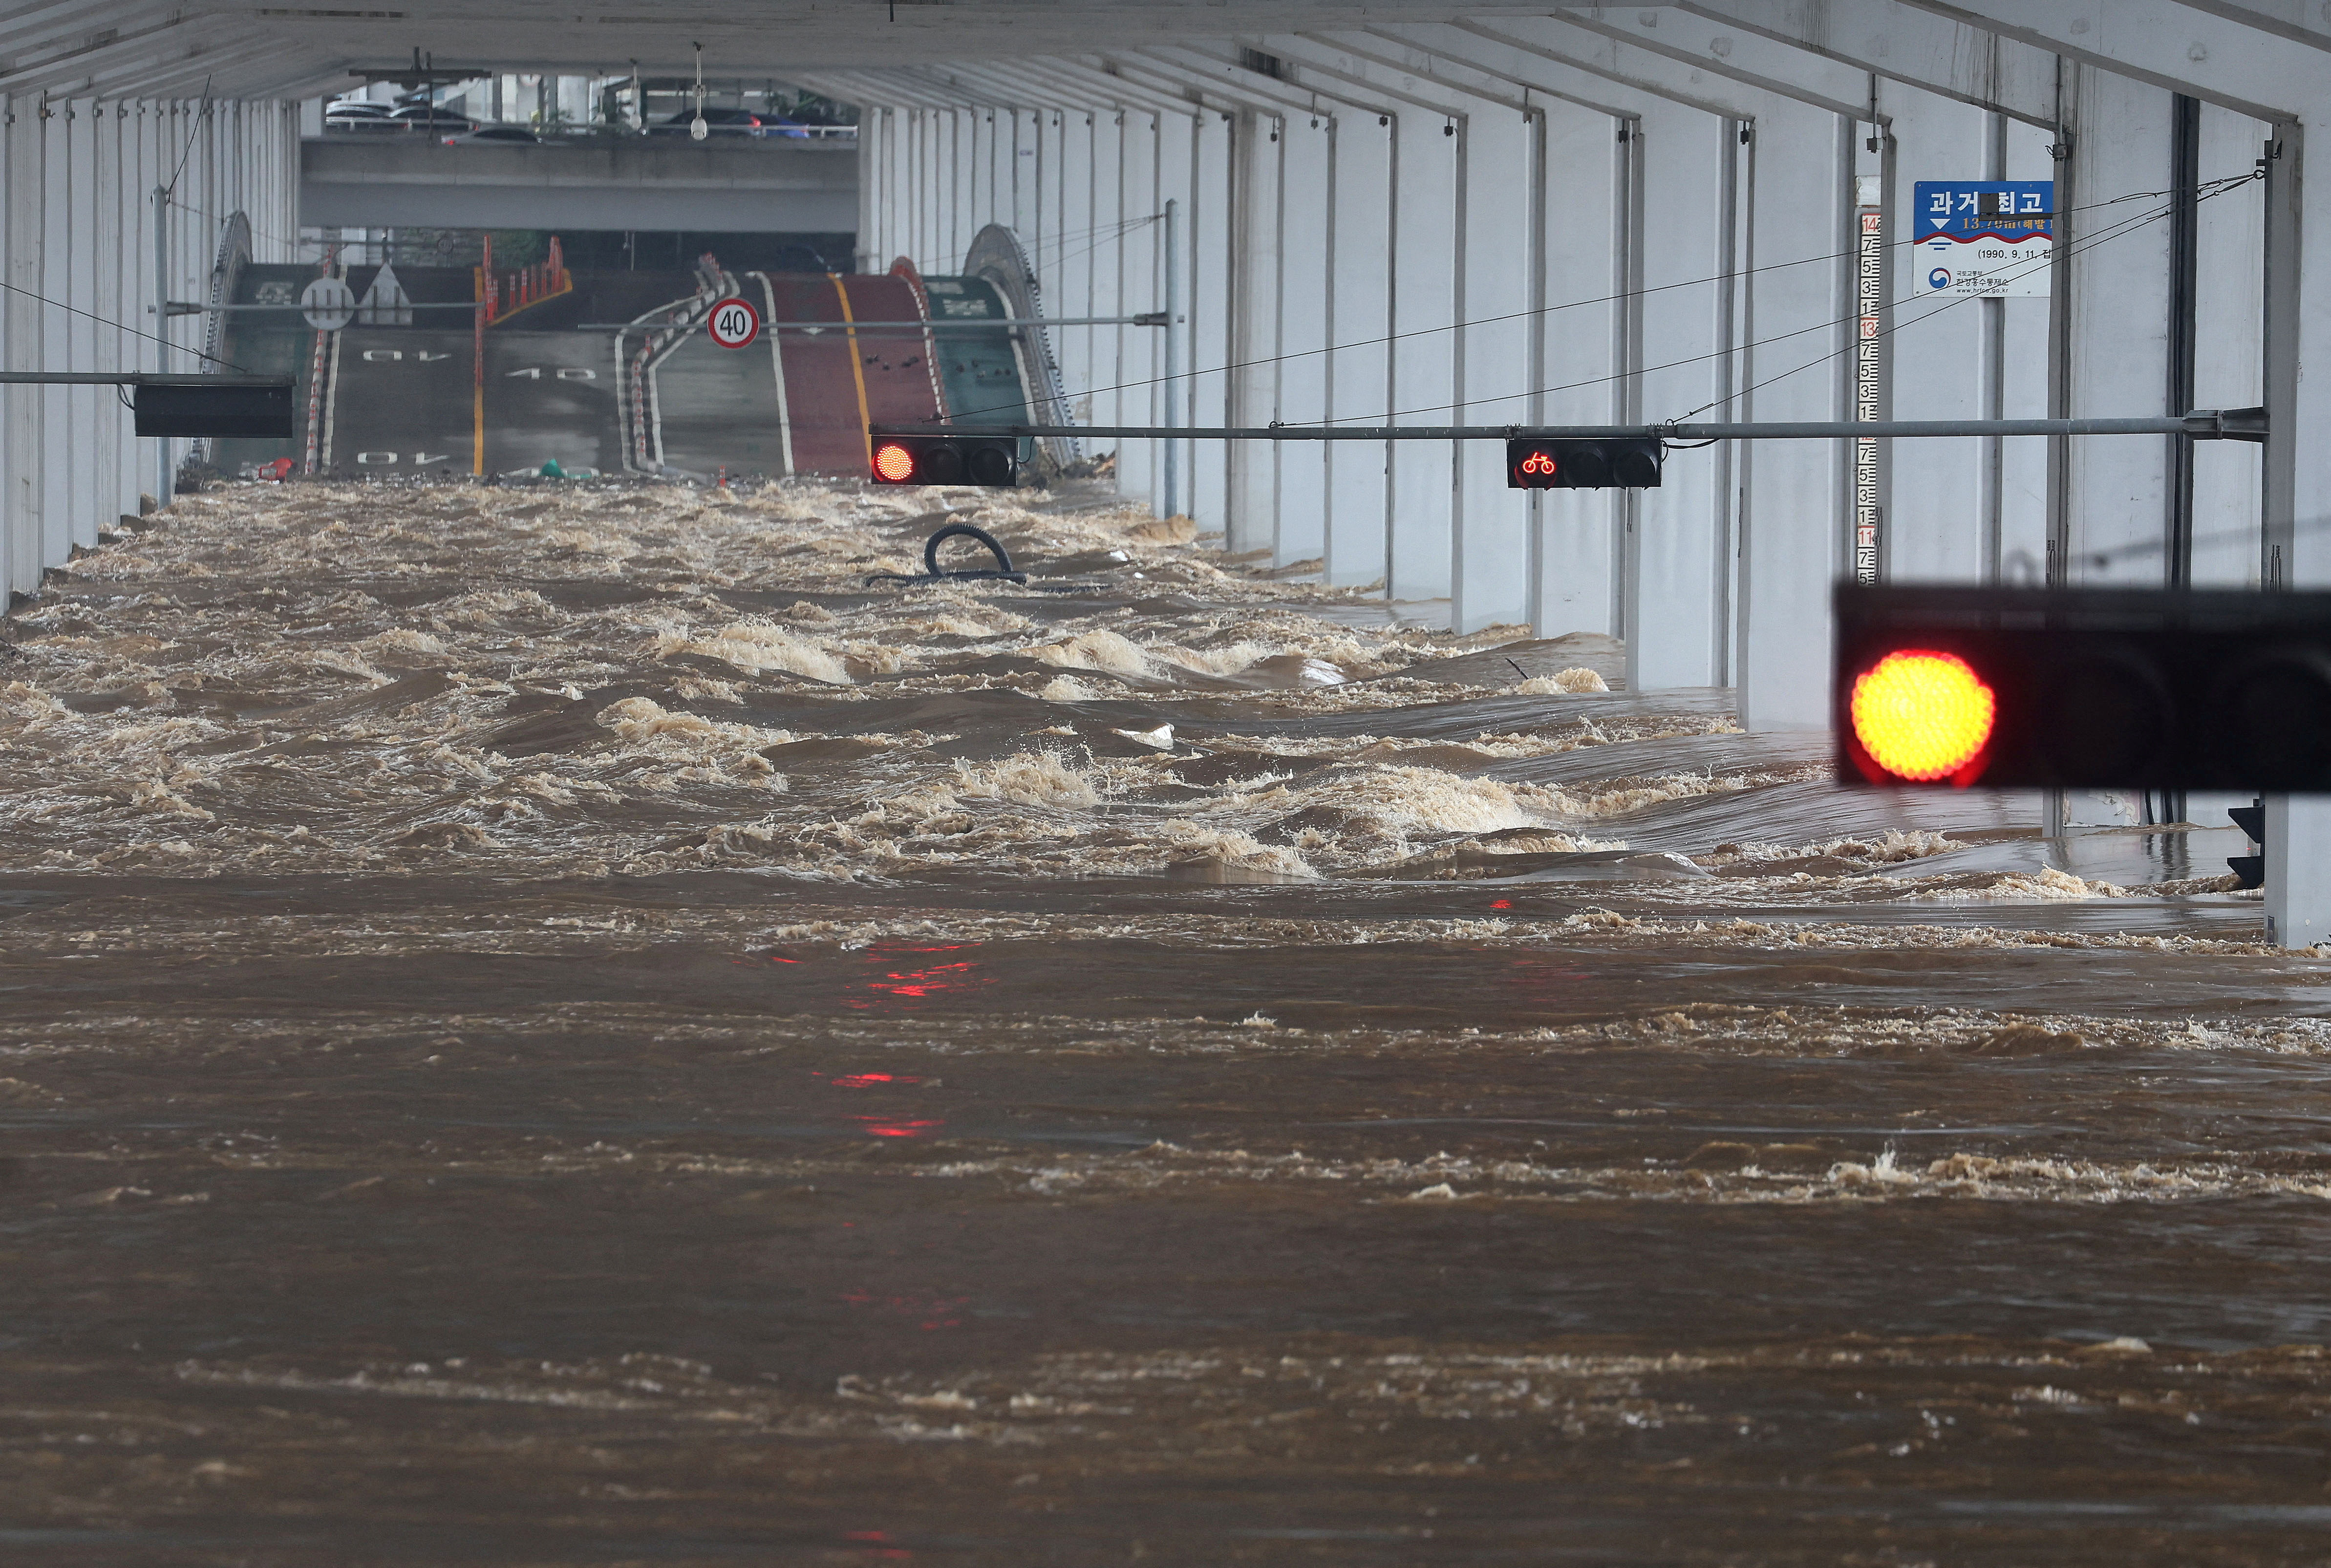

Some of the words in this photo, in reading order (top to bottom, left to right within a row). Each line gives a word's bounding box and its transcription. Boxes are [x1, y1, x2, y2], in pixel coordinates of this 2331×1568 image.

[1929, 191, 1979, 215] 과거
[1998, 191, 2043, 215] 최고
[1862, 217, 1877, 232] 14
[1863, 239, 1872, 252] 7
[1862, 260, 1871, 273] 5
[1862, 281, 1871, 294] 3
[1956, 278, 2010, 287] 한강홍수통제소
[1862, 302, 1868, 313] 1
[720, 310, 746, 337] 40
[1861, 322, 1876, 337] 13
[1861, 344, 1870, 356] 7
[1861, 365, 1869, 377] 5
[1861, 385, 1869, 397] 3
[1861, 406, 1866, 419] 1
[1860, 448, 1868, 460] 7
[1859, 469, 1868, 481] 5
[1859, 490, 1868, 502] 3
[1860, 510, 1865, 522] 1
[1859, 530, 1873, 544] 11
[1859, 552, 1867, 564] 7
[1859, 573, 1867, 584] 5
